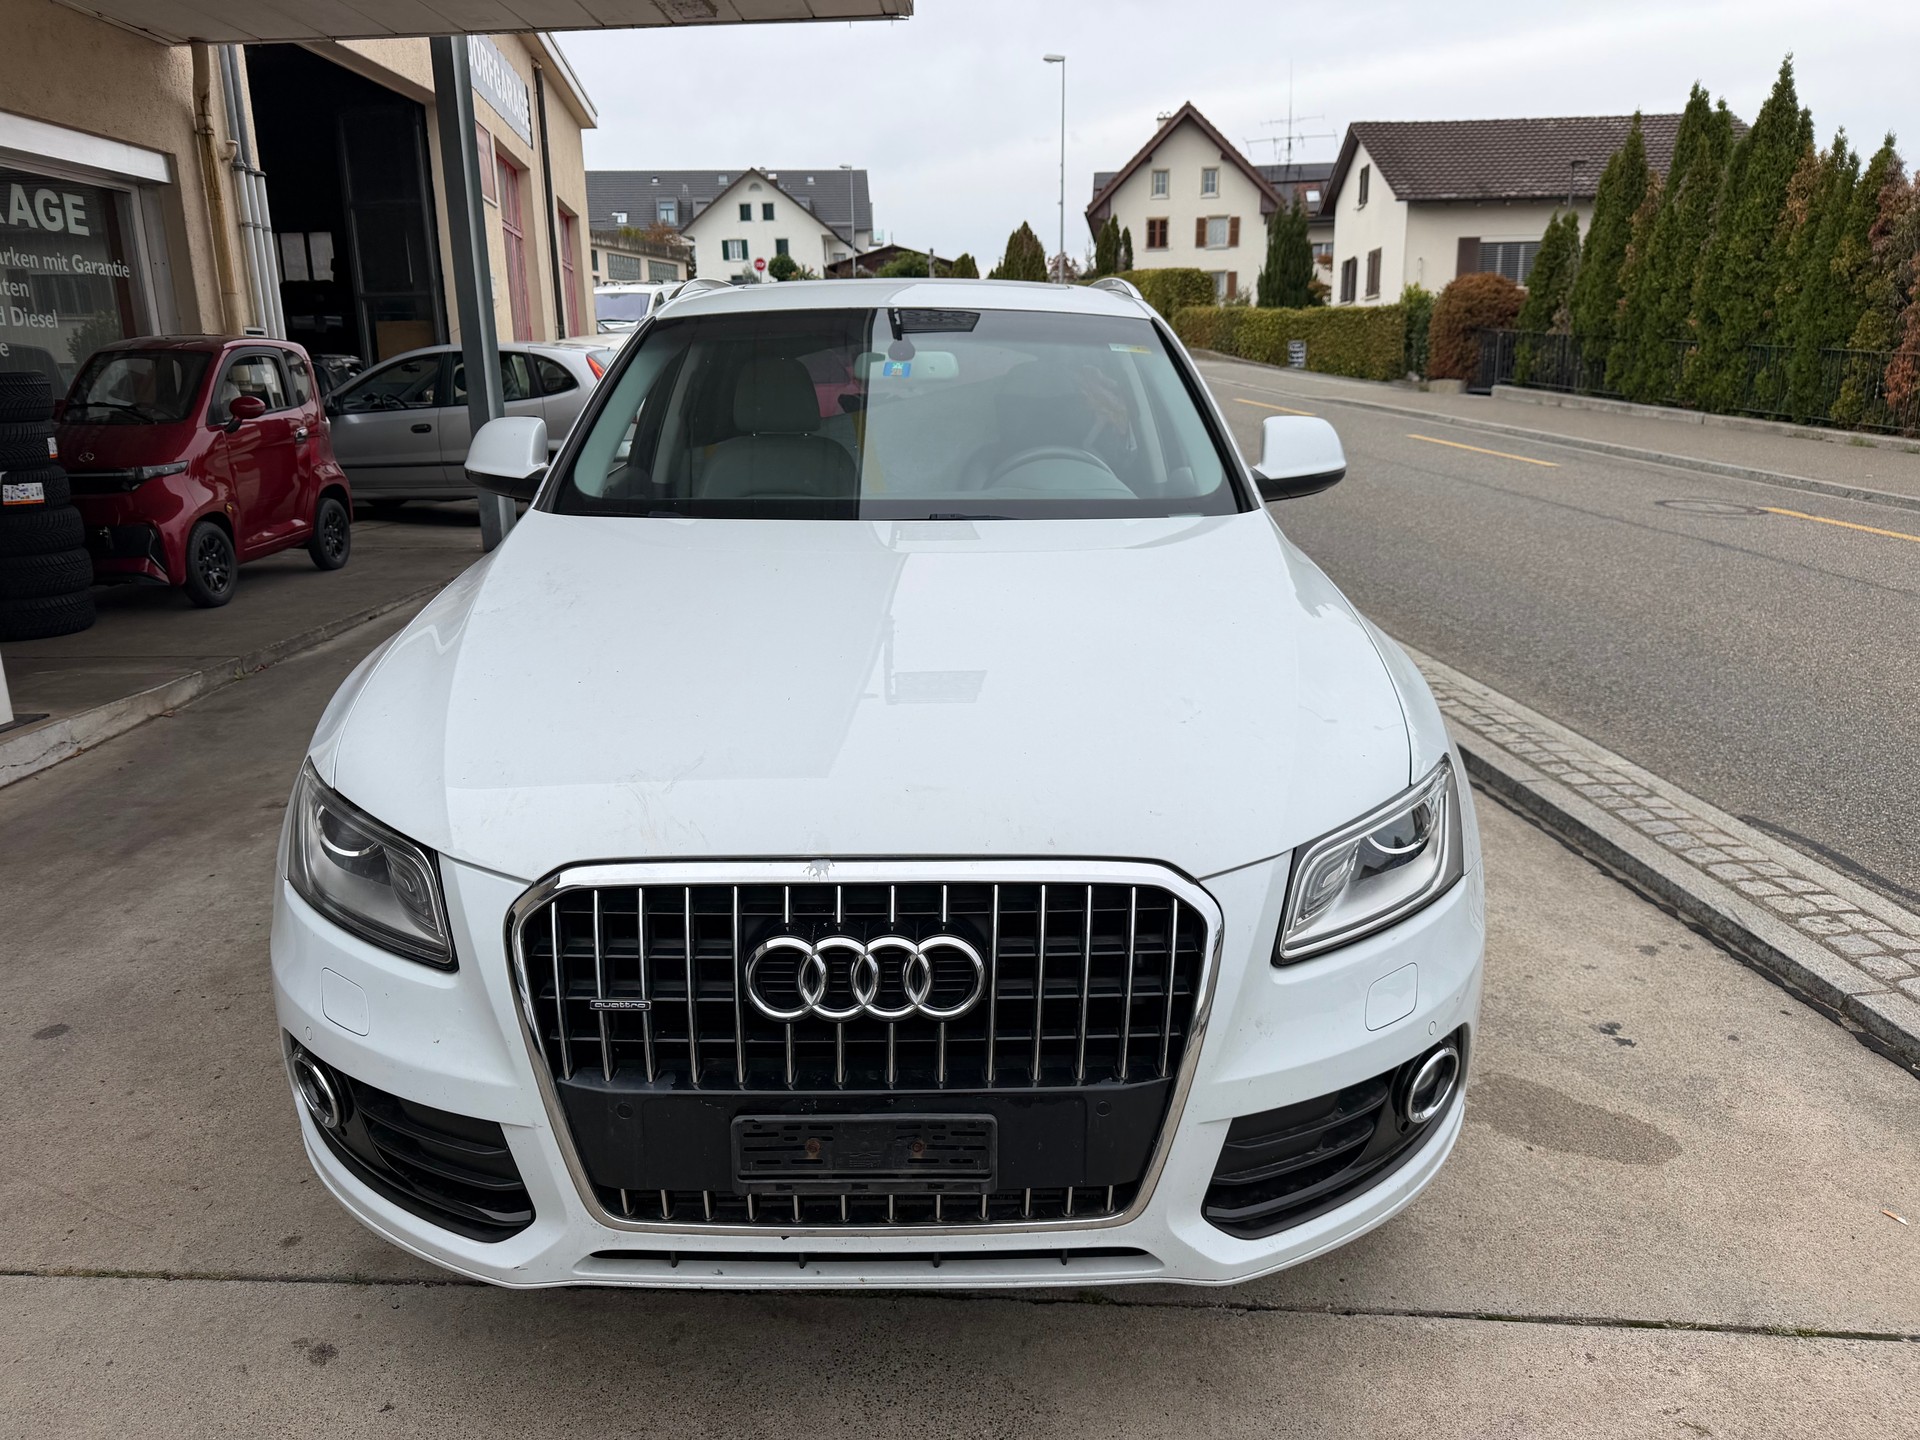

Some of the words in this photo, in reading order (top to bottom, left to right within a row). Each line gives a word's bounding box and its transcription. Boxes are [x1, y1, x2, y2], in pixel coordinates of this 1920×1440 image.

[0, 183, 90, 236] AGE
[43, 252, 69, 272] mit
[72, 254, 130, 278] Garantie
[0, 277, 30, 298] ten
[9, 306, 59, 329] Diesel
